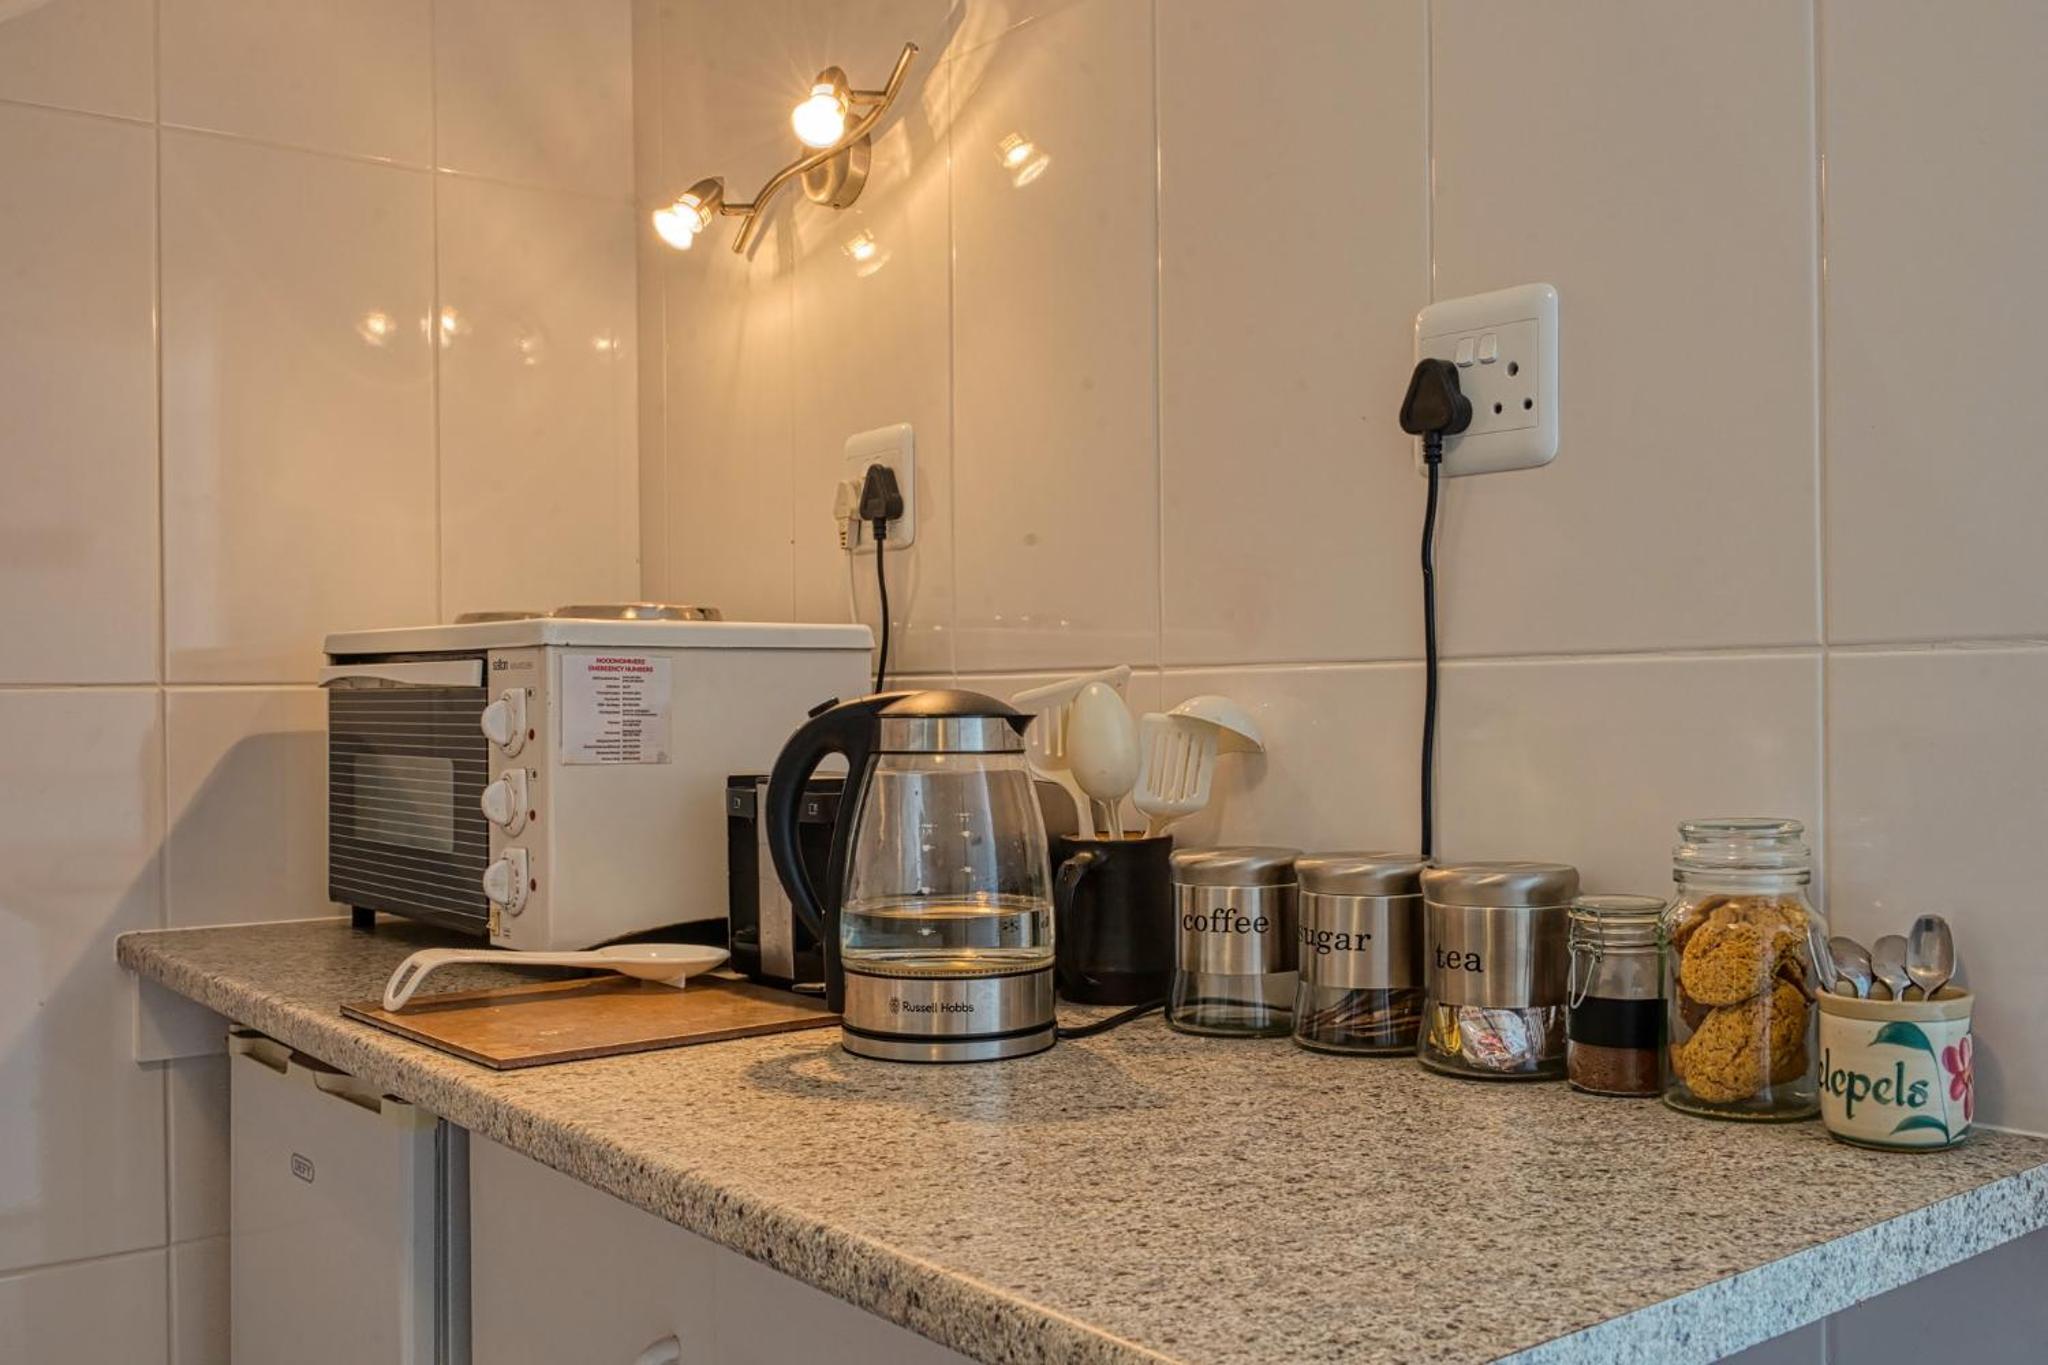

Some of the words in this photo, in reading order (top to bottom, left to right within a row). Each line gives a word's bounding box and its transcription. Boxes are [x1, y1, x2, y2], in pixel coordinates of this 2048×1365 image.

[1183, 907, 1270, 934] coffee
[1435, 942, 1484, 973] tea
[902, 1000, 938, 1013] Russell
[941, 1001, 975, 1013] Hobbs
